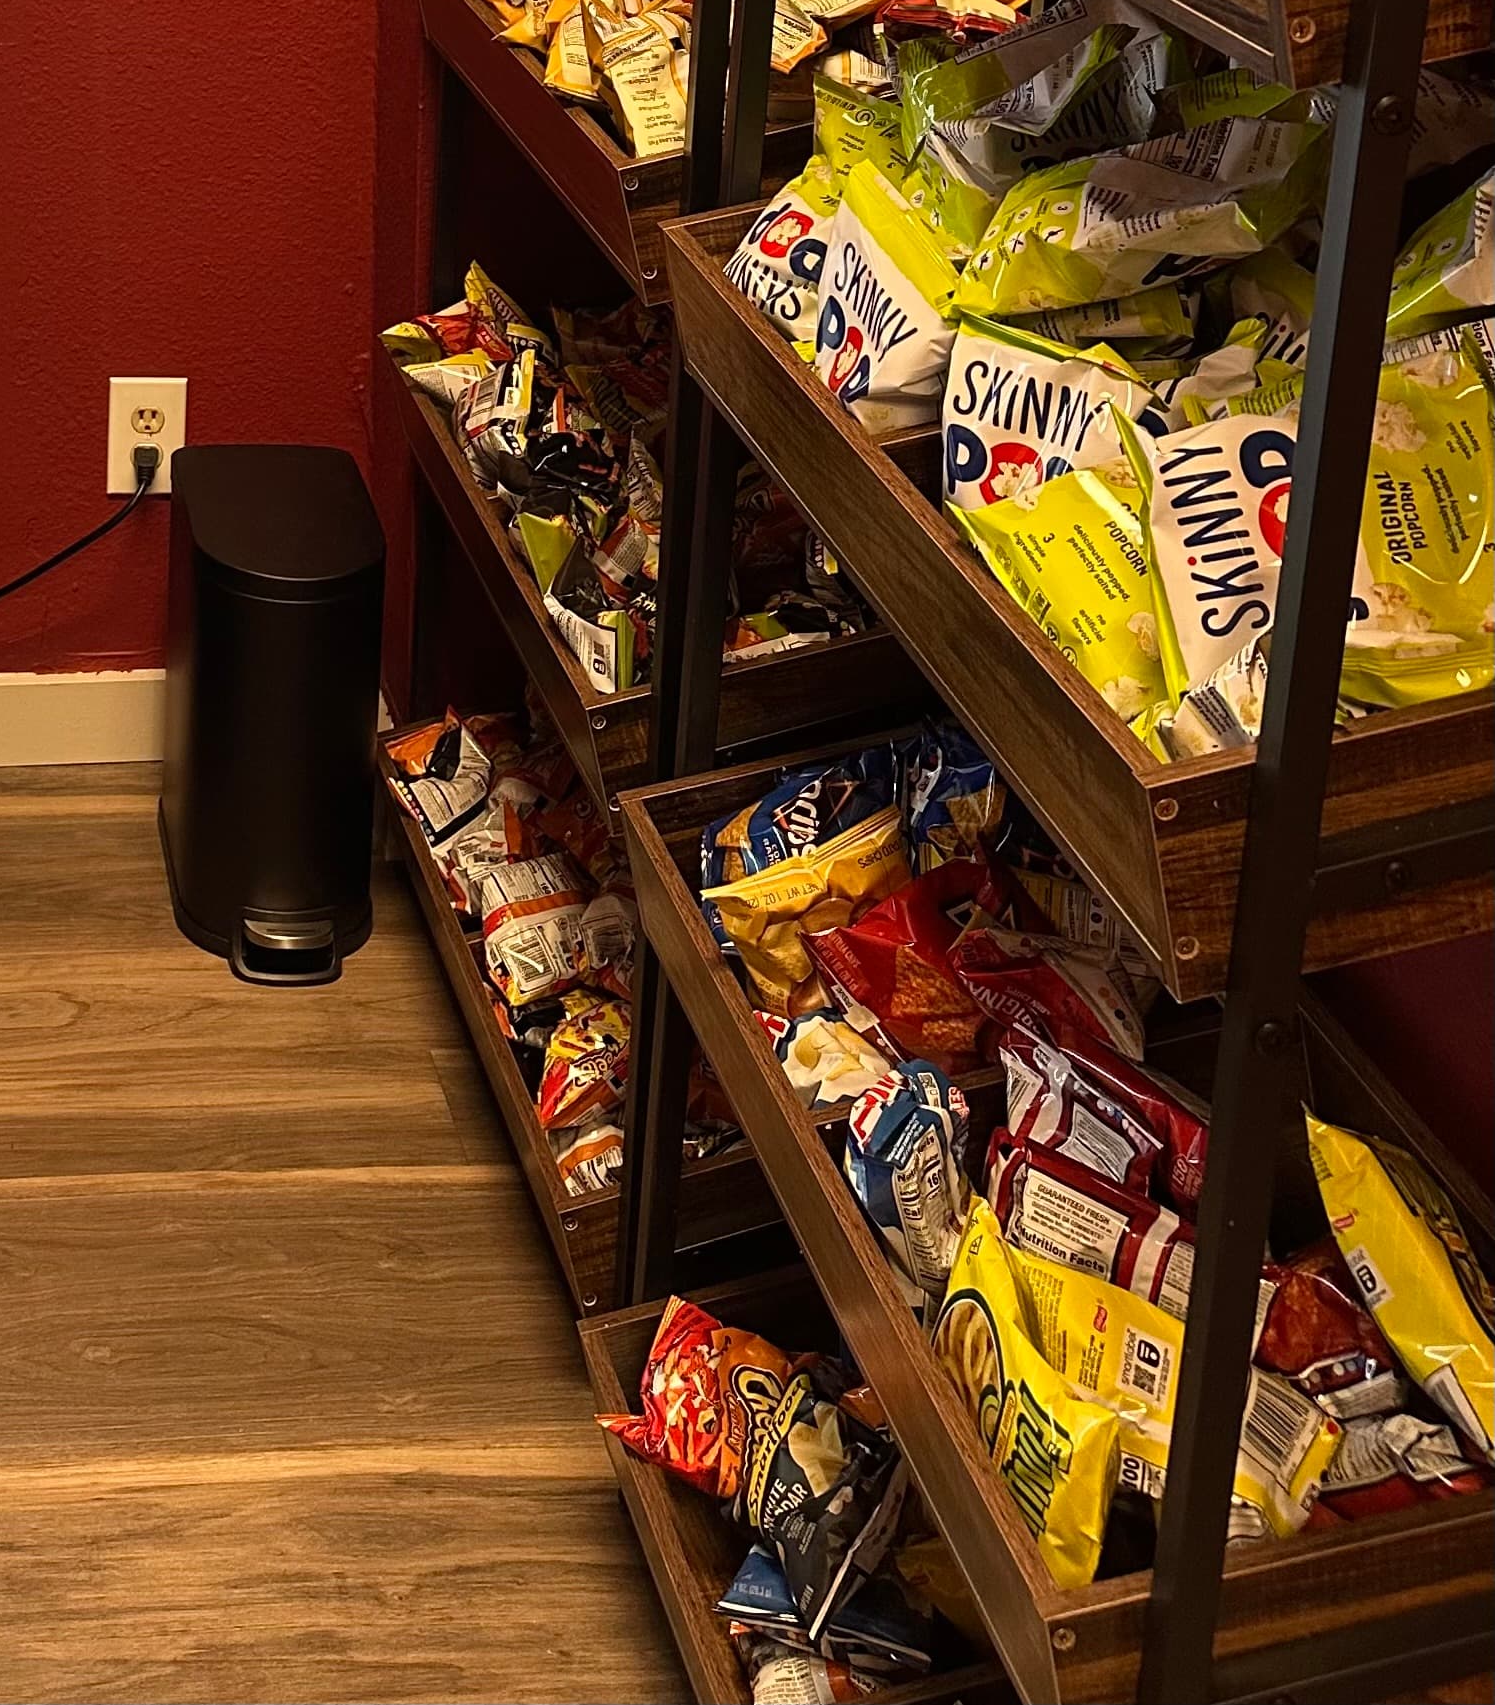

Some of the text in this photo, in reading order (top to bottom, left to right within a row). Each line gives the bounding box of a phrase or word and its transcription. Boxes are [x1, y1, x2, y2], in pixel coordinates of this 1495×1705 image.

[1042, 531, 1056, 544] 3
[1372, 470, 1414, 565] ORIGINAL
[1397, 481, 1428, 551] POPCORN
[1012, 530, 1043, 574] ingredients
[1026, 532, 1047, 559] simple
[1072, 523, 1107, 569] deliciously
[1105, 519, 1149, 578] POPCORN
[1065, 535, 1117, 602] perfectly salted
[1071, 616, 1093, 646] flavors
[1078, 608, 1107, 644] artificial
[1037, 1183, 1111, 1226] GUARANTEED FRESH
[1069, 1252, 1106, 1274] Facts
[763, 1478, 787, 1530] WHITE
